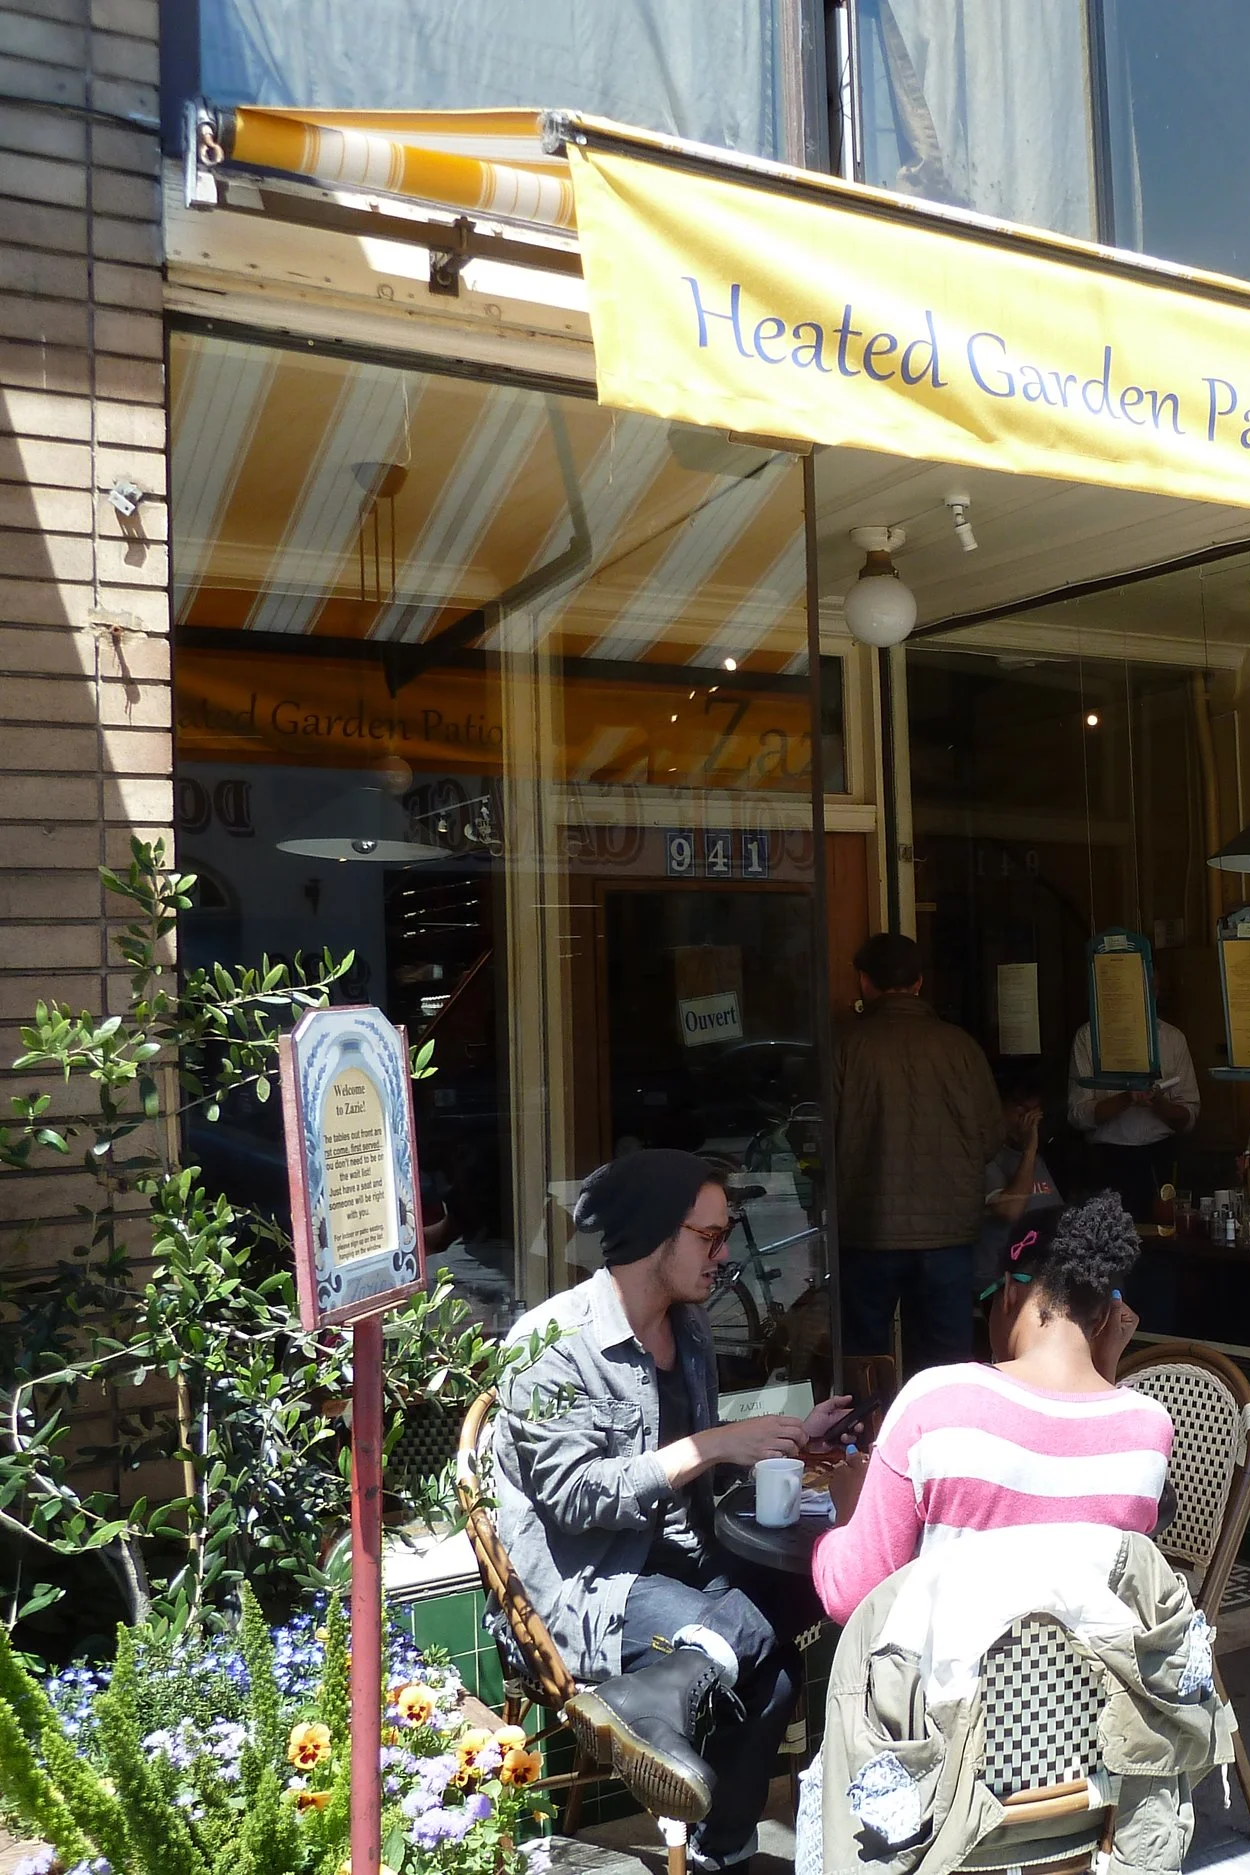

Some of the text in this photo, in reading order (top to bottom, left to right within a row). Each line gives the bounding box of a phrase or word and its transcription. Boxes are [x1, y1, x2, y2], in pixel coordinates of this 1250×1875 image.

[680, 276, 949, 390] Heated
[965, 331, 1186, 435] Garden
[669, 837, 764, 872] 941
[685, 1006, 737, 1033] Ouvert
[333, 1084, 366, 1097] Welcome
[336, 1100, 366, 1116] to Zazie!
[333, 1132, 350, 1143] tables
[351, 1130, 361, 1139] out
[361, 1128, 374, 1138] front
[351, 1143, 362, 1153] first
[350, 1156, 363, 1166] need
[339, 1172, 349, 1181] the
[329, 1188, 342, 1198] Just
[342, 1184, 356, 1194] have
[361, 1181, 372, 1191] seat
[372, 1177, 383, 1188] and
[328, 1199, 354, 1211] someone
